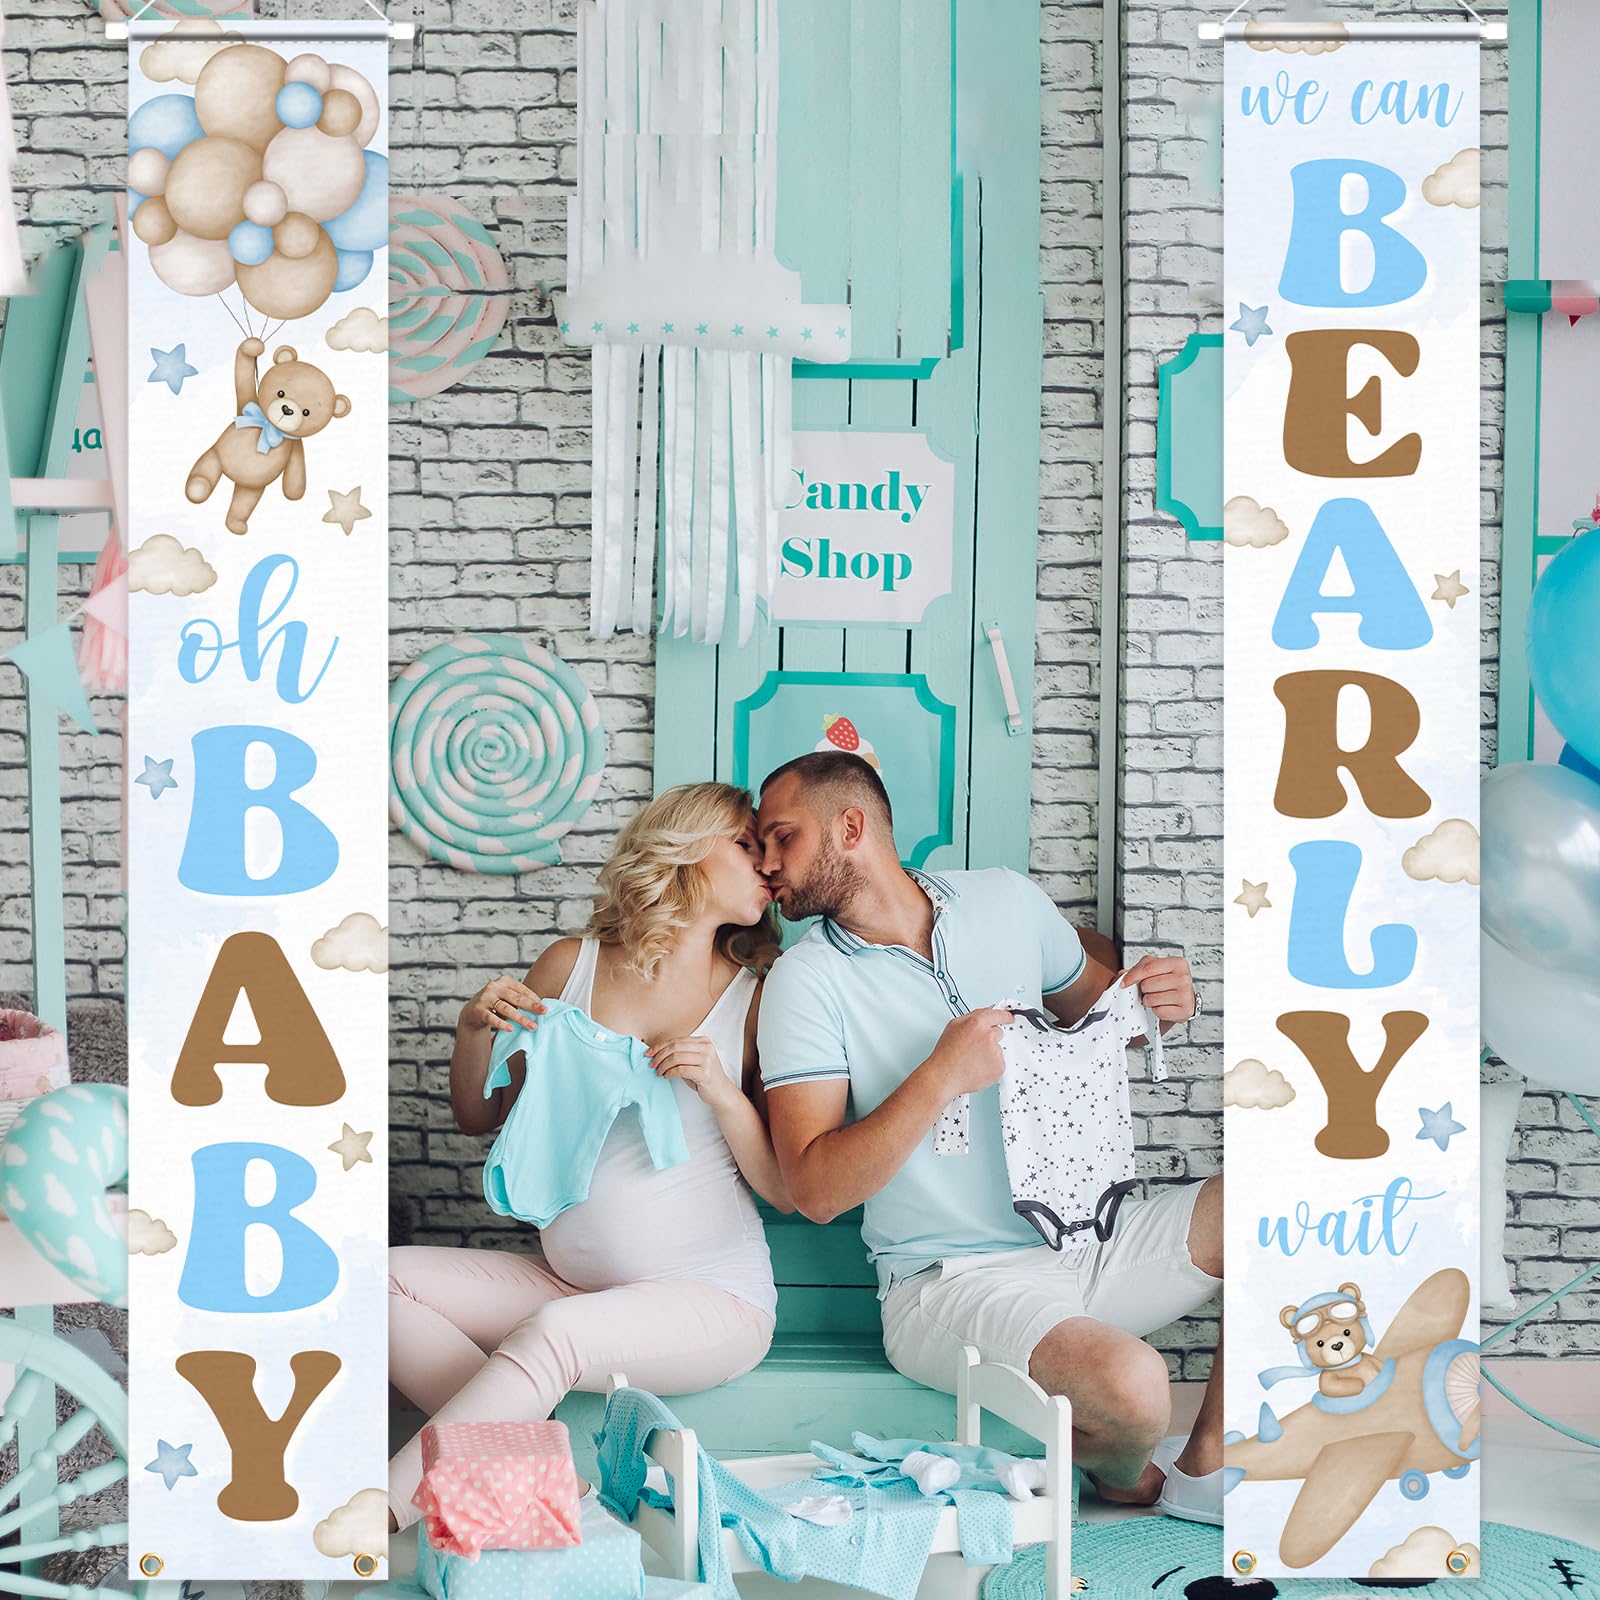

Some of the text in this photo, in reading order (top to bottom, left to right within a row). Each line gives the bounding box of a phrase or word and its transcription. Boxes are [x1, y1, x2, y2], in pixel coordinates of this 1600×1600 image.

[1241, 70, 1463, 127] we can
[780, 537, 913, 592] Shop
[177, 553, 339, 704] oh
[1271, 159, 1434, 1159] BEARLY
[172, 725, 345, 1521] BABY
[1258, 1176, 1446, 1257] wait
